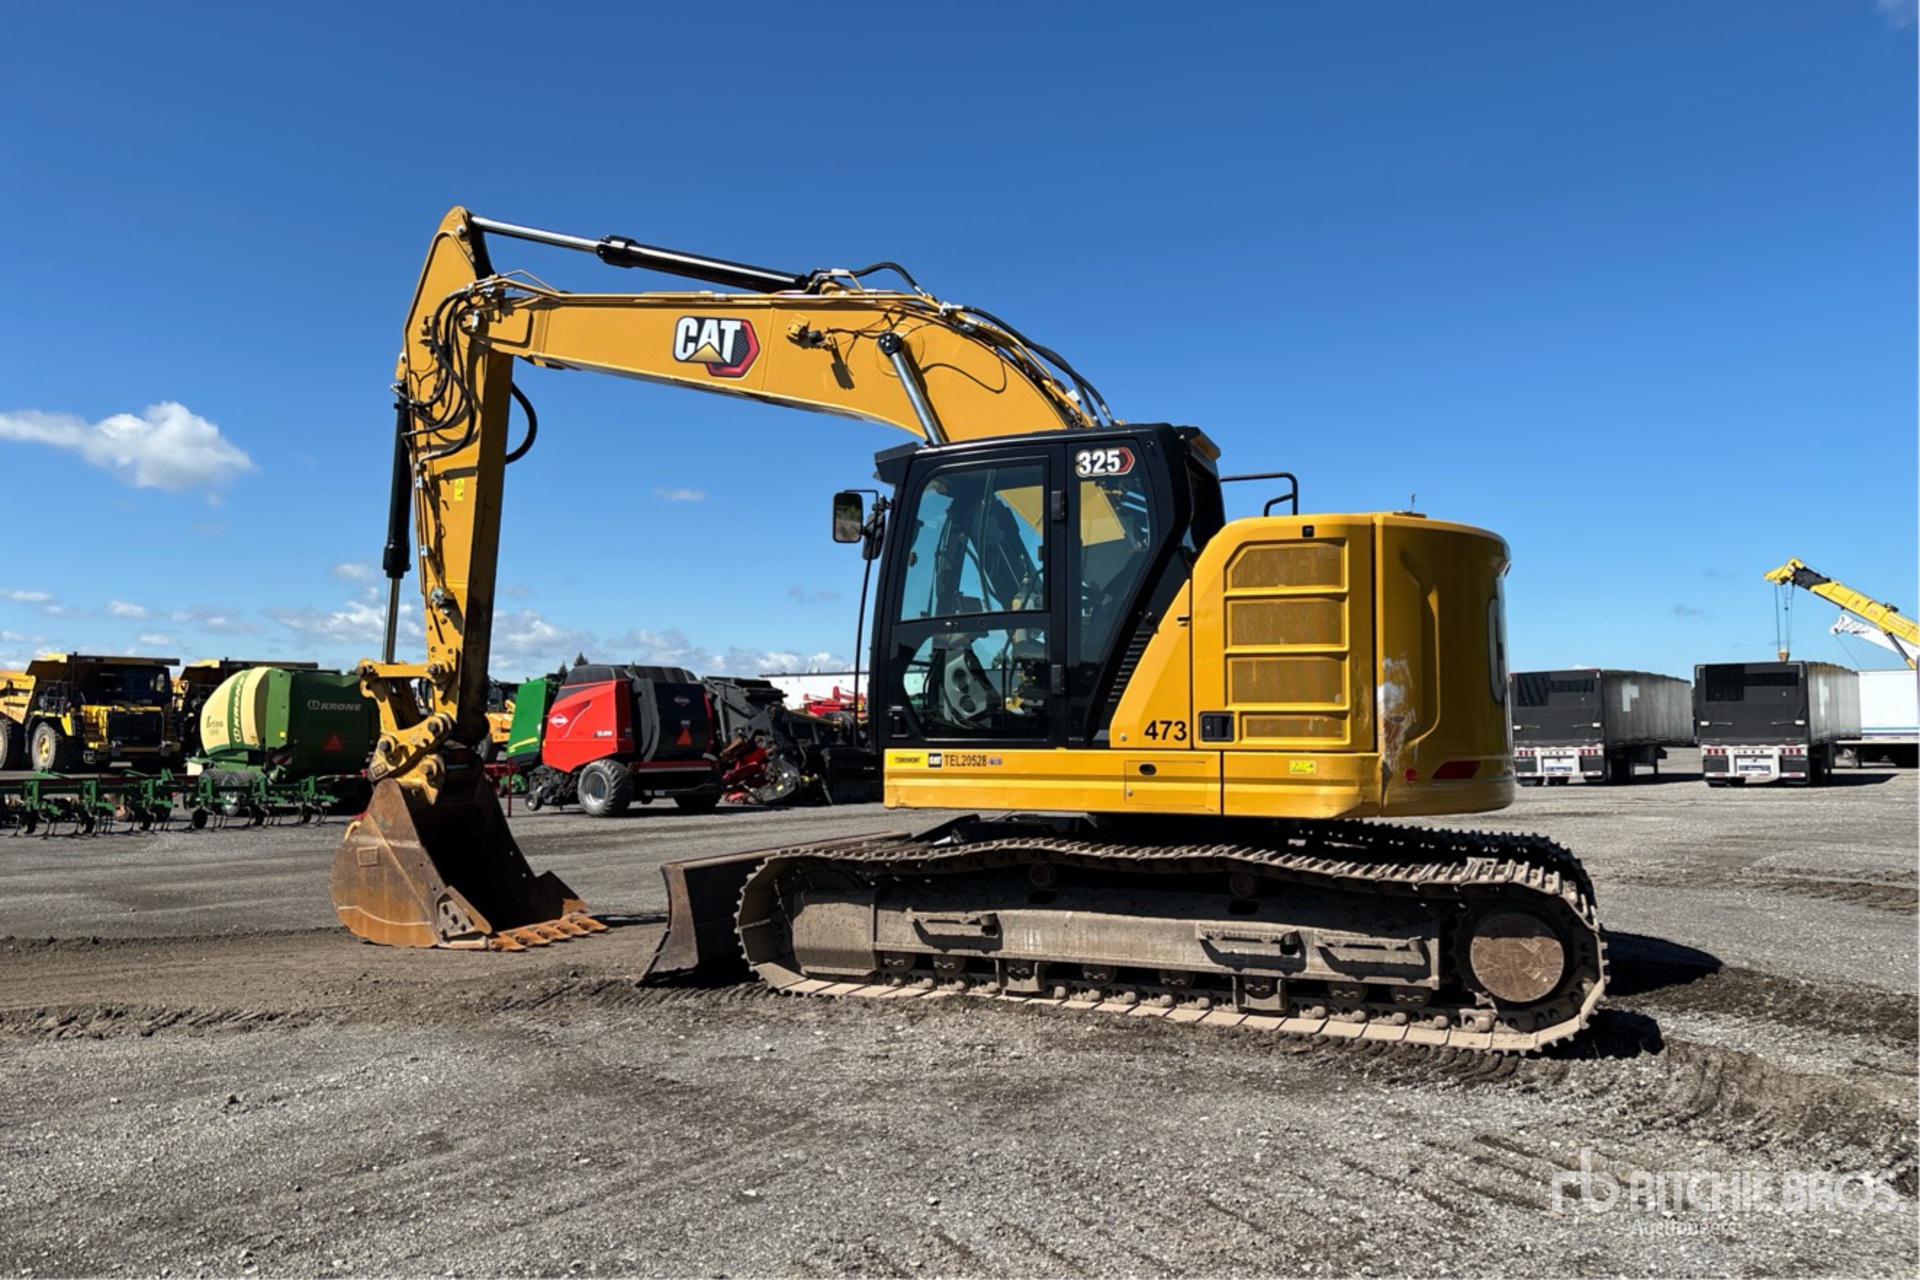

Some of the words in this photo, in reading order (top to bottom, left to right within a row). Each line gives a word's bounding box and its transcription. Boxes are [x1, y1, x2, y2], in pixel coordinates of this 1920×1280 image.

[674, 317, 741, 363] CAT
[1078, 450, 1121, 475] 325
[320, 702, 362, 711] KRONE
[1144, 719, 1187, 741] 473
[944, 754, 988, 767] TEL20528
